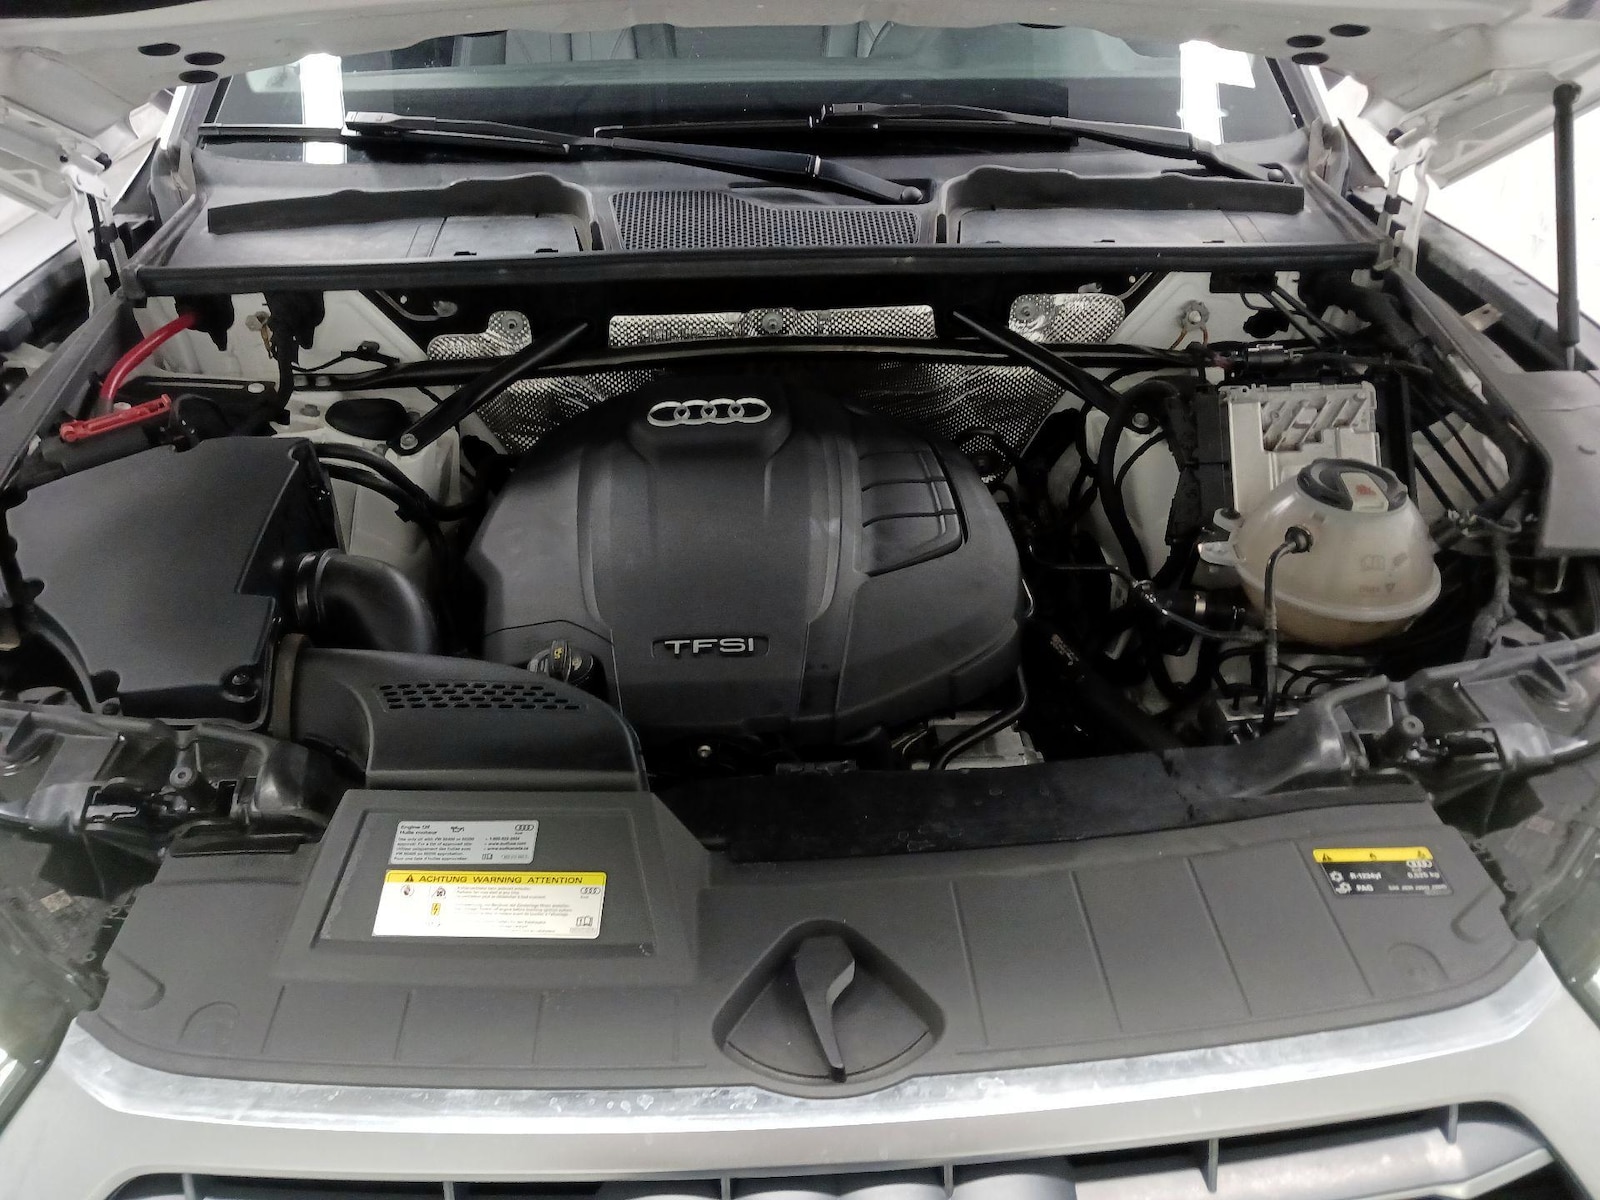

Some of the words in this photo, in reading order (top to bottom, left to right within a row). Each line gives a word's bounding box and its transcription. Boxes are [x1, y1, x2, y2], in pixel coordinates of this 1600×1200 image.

[664, 637, 754, 655] TFSI
[418, 875, 468, 883] ACHTUNG
[473, 876, 522, 884] WARNING
[527, 876, 583, 885] ATTENTION
[1355, 884, 1374, 892] PAG
